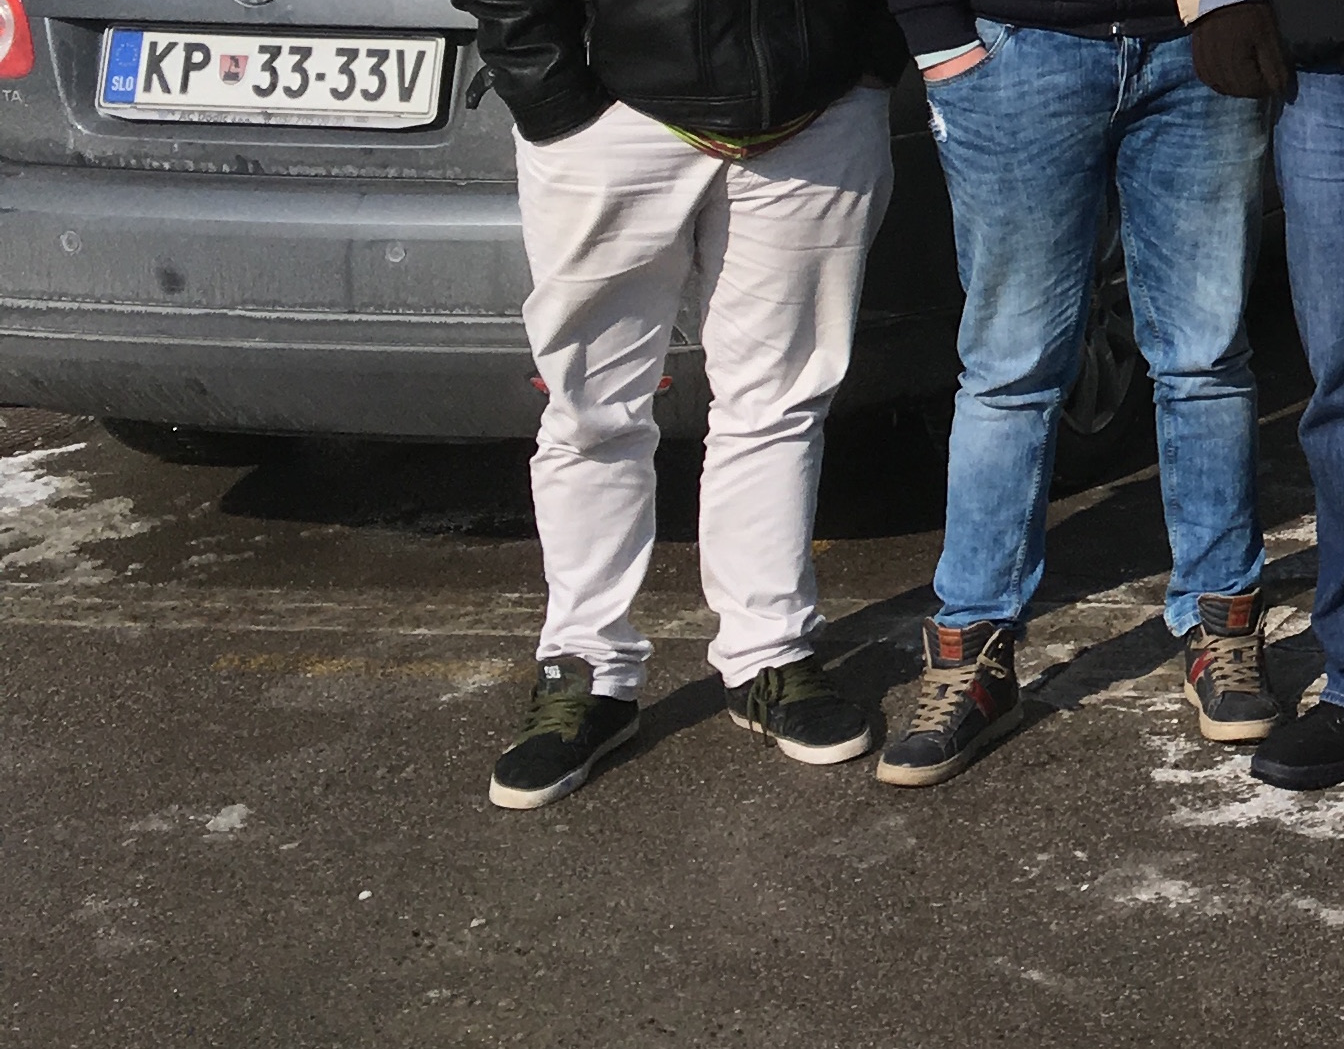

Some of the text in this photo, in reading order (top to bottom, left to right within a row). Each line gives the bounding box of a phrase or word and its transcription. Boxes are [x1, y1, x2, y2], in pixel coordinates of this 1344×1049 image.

[111, 76, 134, 92] SLO
[142, 41, 427, 103] KP 33-33V
